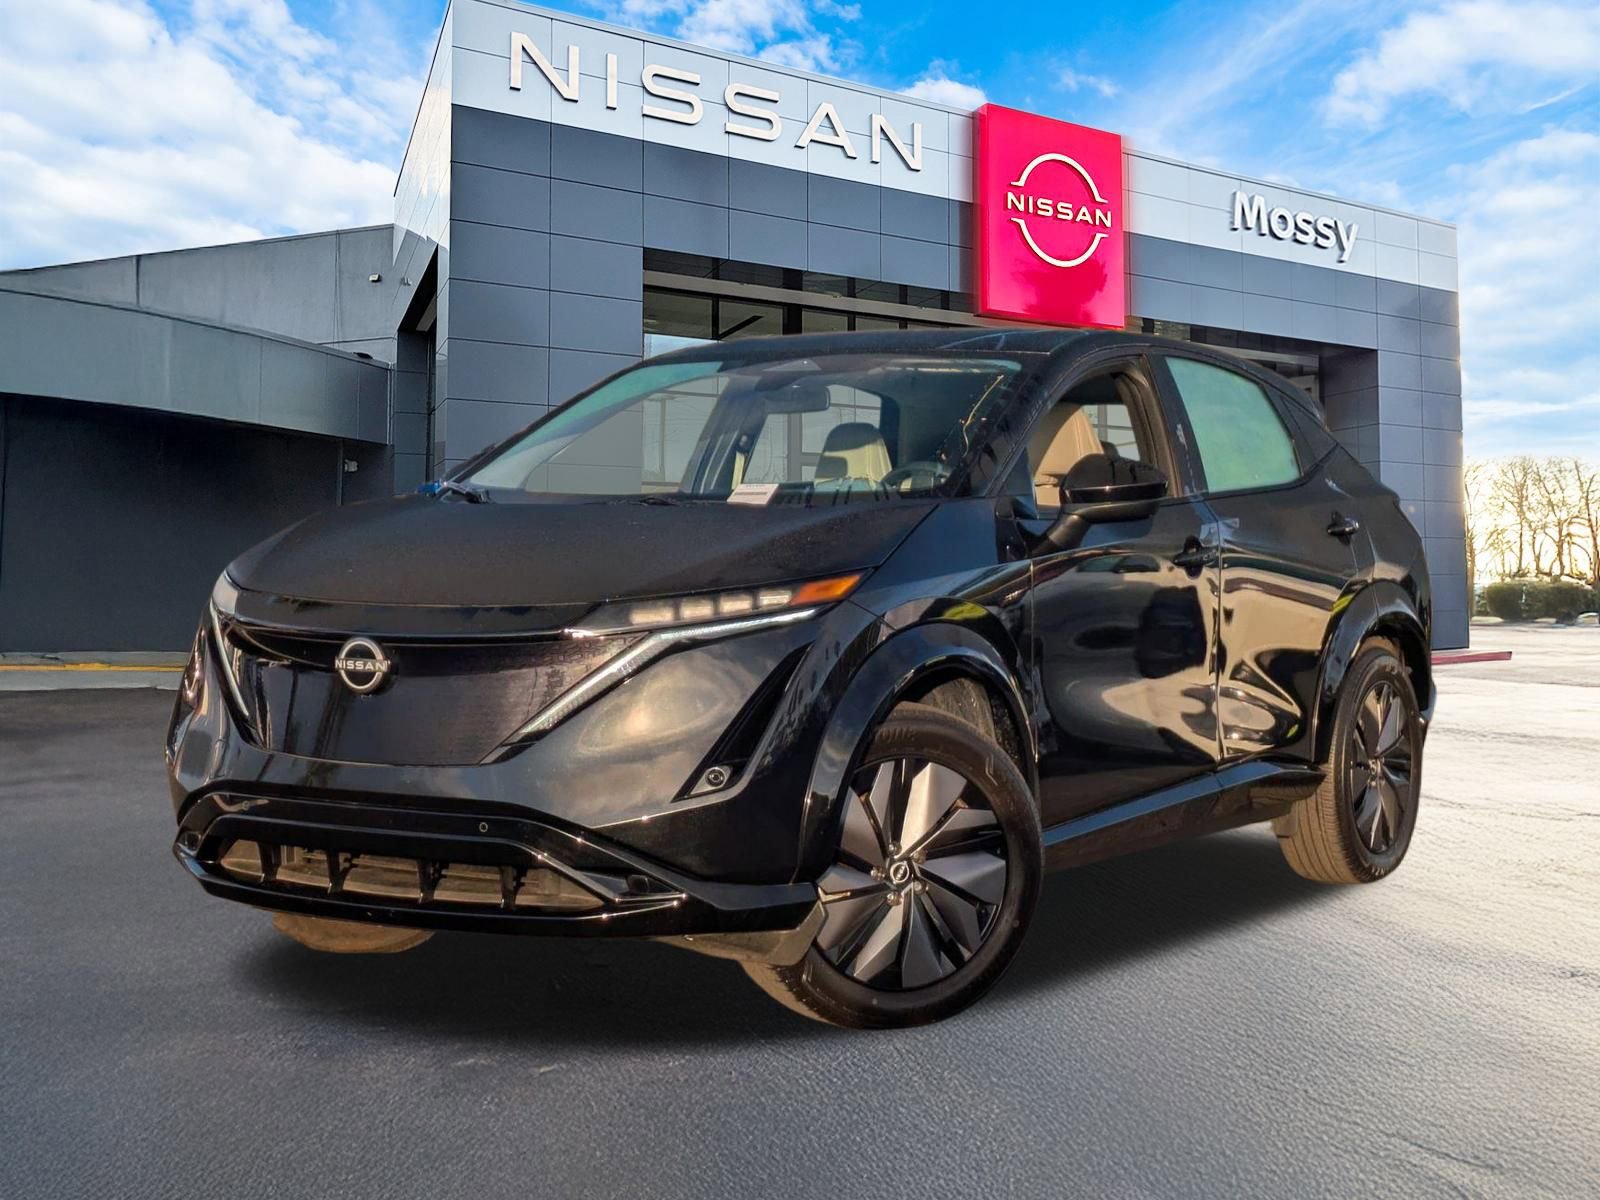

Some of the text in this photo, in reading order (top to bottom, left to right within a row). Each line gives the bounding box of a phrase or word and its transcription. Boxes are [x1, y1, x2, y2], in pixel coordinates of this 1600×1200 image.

[509, 31, 923, 172] NISSAN
[1007, 191, 1112, 228] NISSAN
[1231, 190, 1358, 263] Mossy
[335, 659, 387, 672] NISSAN
